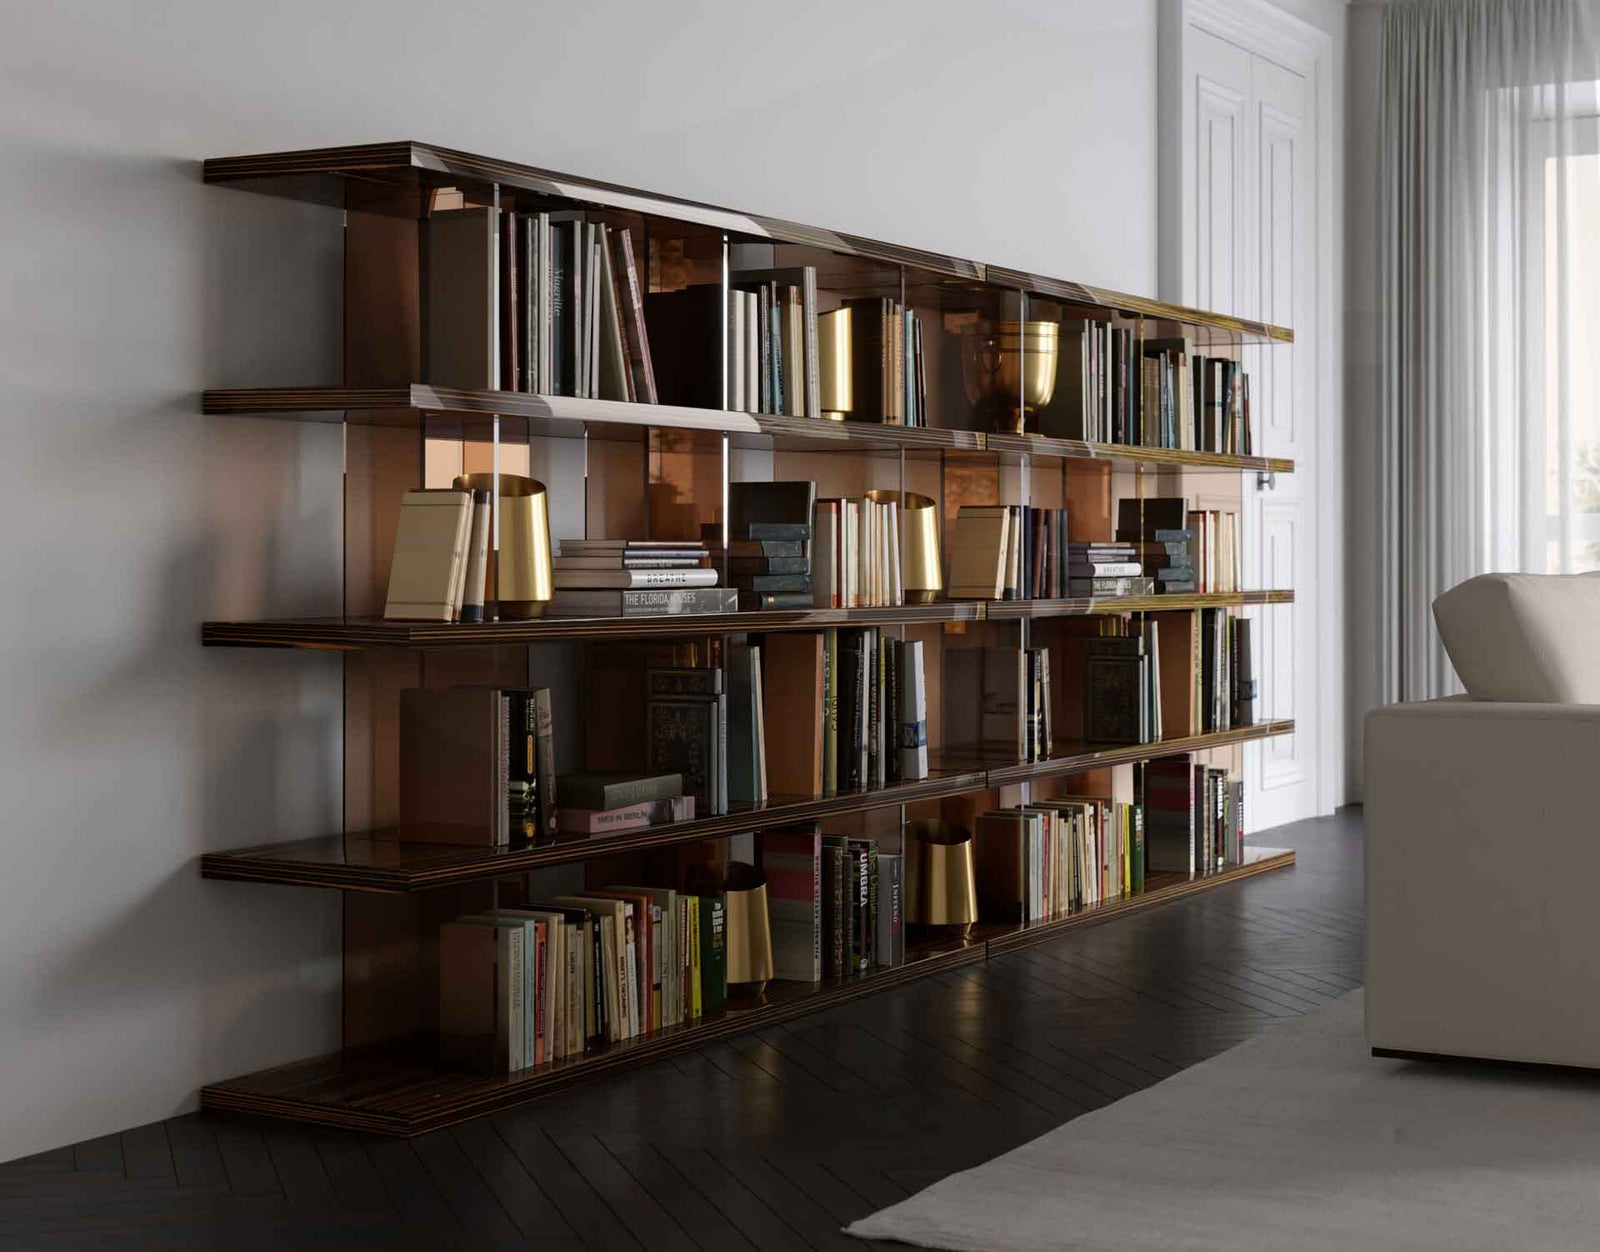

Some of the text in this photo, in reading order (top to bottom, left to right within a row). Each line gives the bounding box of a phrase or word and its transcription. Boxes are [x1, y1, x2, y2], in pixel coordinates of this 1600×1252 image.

[553, 268, 564, 318] Magritte
[647, 572, 687, 583] BREATHE
[625, 594, 639, 606] THE
[639, 593, 669, 605] FLORIDA
[859, 852, 869, 908] UMBRA
